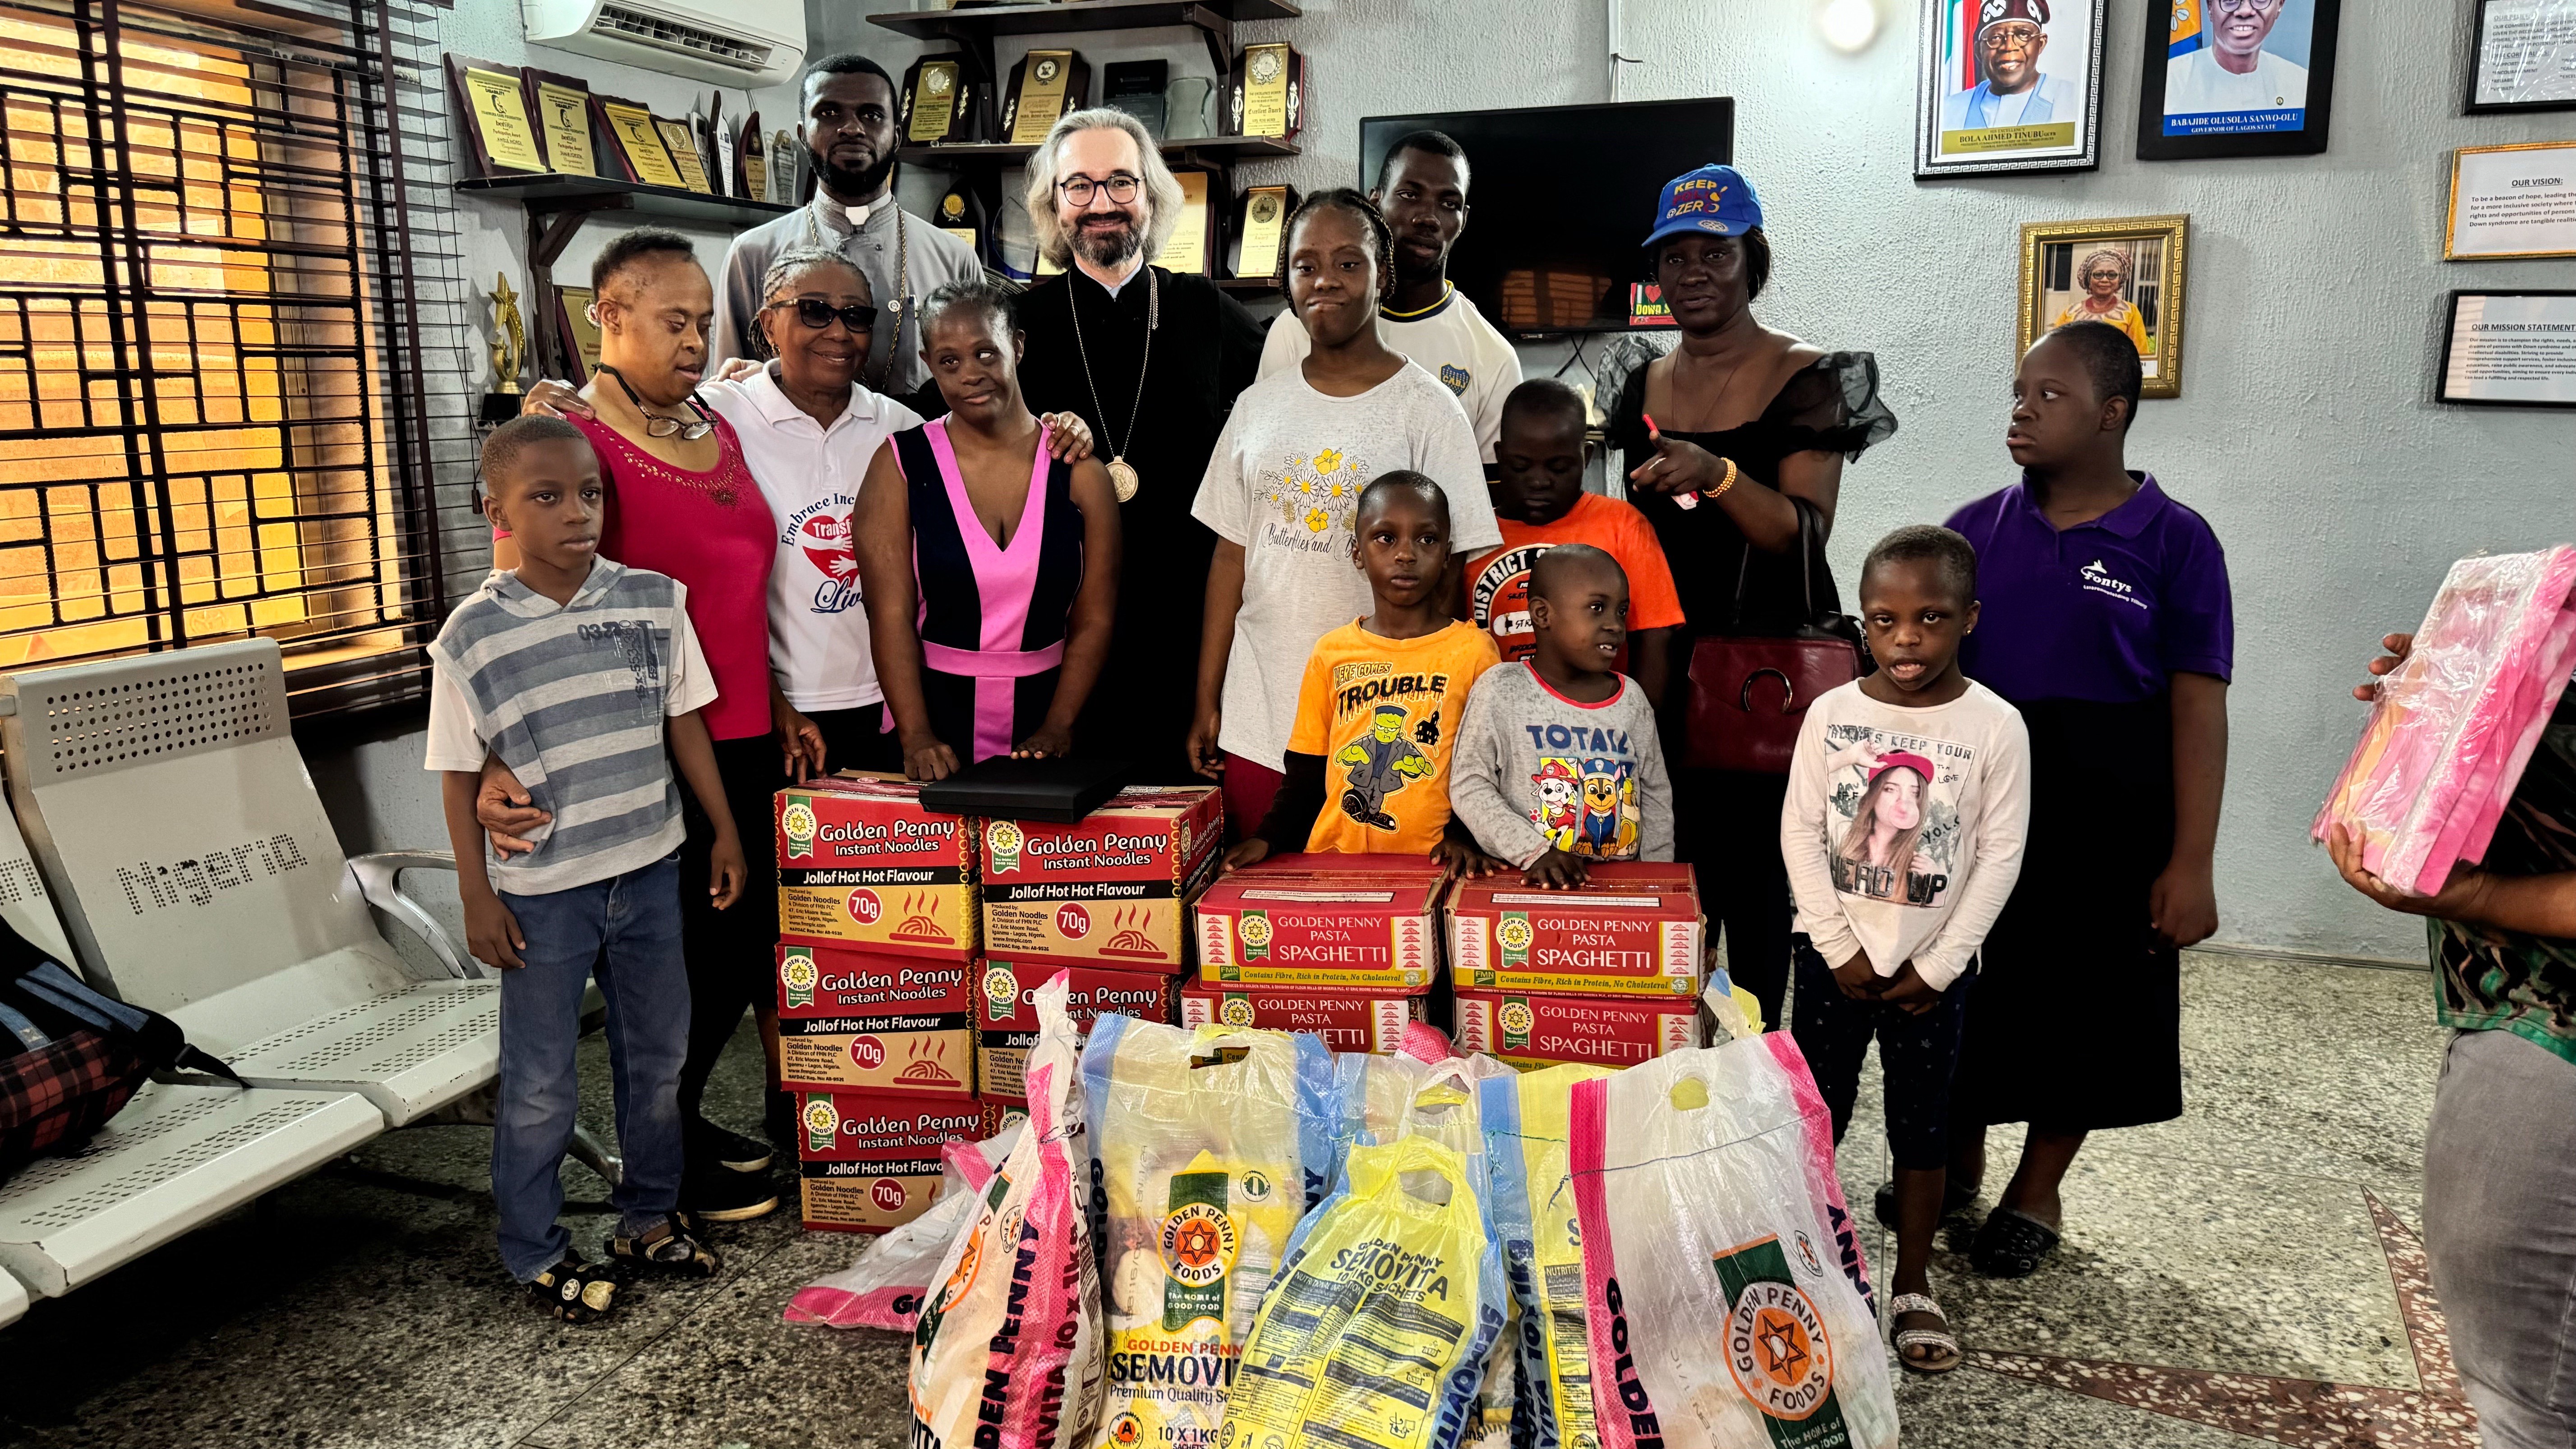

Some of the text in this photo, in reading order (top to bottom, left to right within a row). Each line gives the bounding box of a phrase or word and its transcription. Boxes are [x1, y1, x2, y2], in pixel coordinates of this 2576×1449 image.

[2171, 113, 2297, 126] BABAJIDE OLUSOLA SANWO-OLU
[1983, 133, 2012, 142] AHMED
[2015, 131, 2044, 139] TINUBU
[1674, 179, 1716, 195] KEEP
[1636, 304, 1661, 315] Down
[1443, 375, 1466, 389] CABJ
[782, 497, 830, 547] Embrace
[813, 519, 852, 537] Transf
[1261, 523, 1310, 552] Butterflies
[1311, 534, 1333, 553] and
[1474, 550, 1527, 620] DISTRICT
[2084, 570, 2132, 593] Fontys
[1334, 663, 1390, 684] HERE COMES
[1338, 676, 1447, 725] TROUBLE
[1891, 736, 1972, 760] KEEP YOUR
[820, 820, 954, 841] Golden Penny
[835, 839, 939, 856] Instant Noodles
[1027, 833, 1167, 855] Golden Penny
[1044, 853, 1151, 869] Instant Noodles
[116, 833, 308, 915] Nigeria
[804, 870, 934, 884] Jollof Hot Hot Flavour
[1830, 855, 1948, 904] HEAD UP
[1009, 883, 1145, 899] Jollof Hot Hot Flavour
[852, 897, 878, 919] 70g
[1019, 911, 1048, 919] Noodles
[1060, 911, 1086, 934] 70g
[1278, 916, 1382, 929] GOLDEN PENNY
[1537, 919, 1652, 933] GOLDEN PENNY
[1311, 930, 1351, 941] PASTA
[1573, 934, 1616, 946] PASTA
[1280, 946, 1386, 962] SPAGHETTI
[1537, 948, 1651, 968] SPAGHETTI
[822, 969, 962, 991] Golden Penny
[838, 986, 946, 1004] Instant Noodles
[805, 1017, 940, 1033] Jollof Hot Hot Flavour
[855, 1044, 881, 1064] 70g
[1164, 1205, 1233, 1255] GOLDEN PENNY
[1173, 1262, 1221, 1281] FOODS
[989, 1219, 1039, 1354] PENNY
[1733, 1287, 1824, 1372] GOLDEN PENNY
[1128, 1339, 1243, 1355] GOLDEN PENN
[1110, 1352, 1240, 1386] SEMOVI
[1110, 1385, 1212, 1405] Premium Quality
[1769, 1371, 1825, 1411] FOODS
